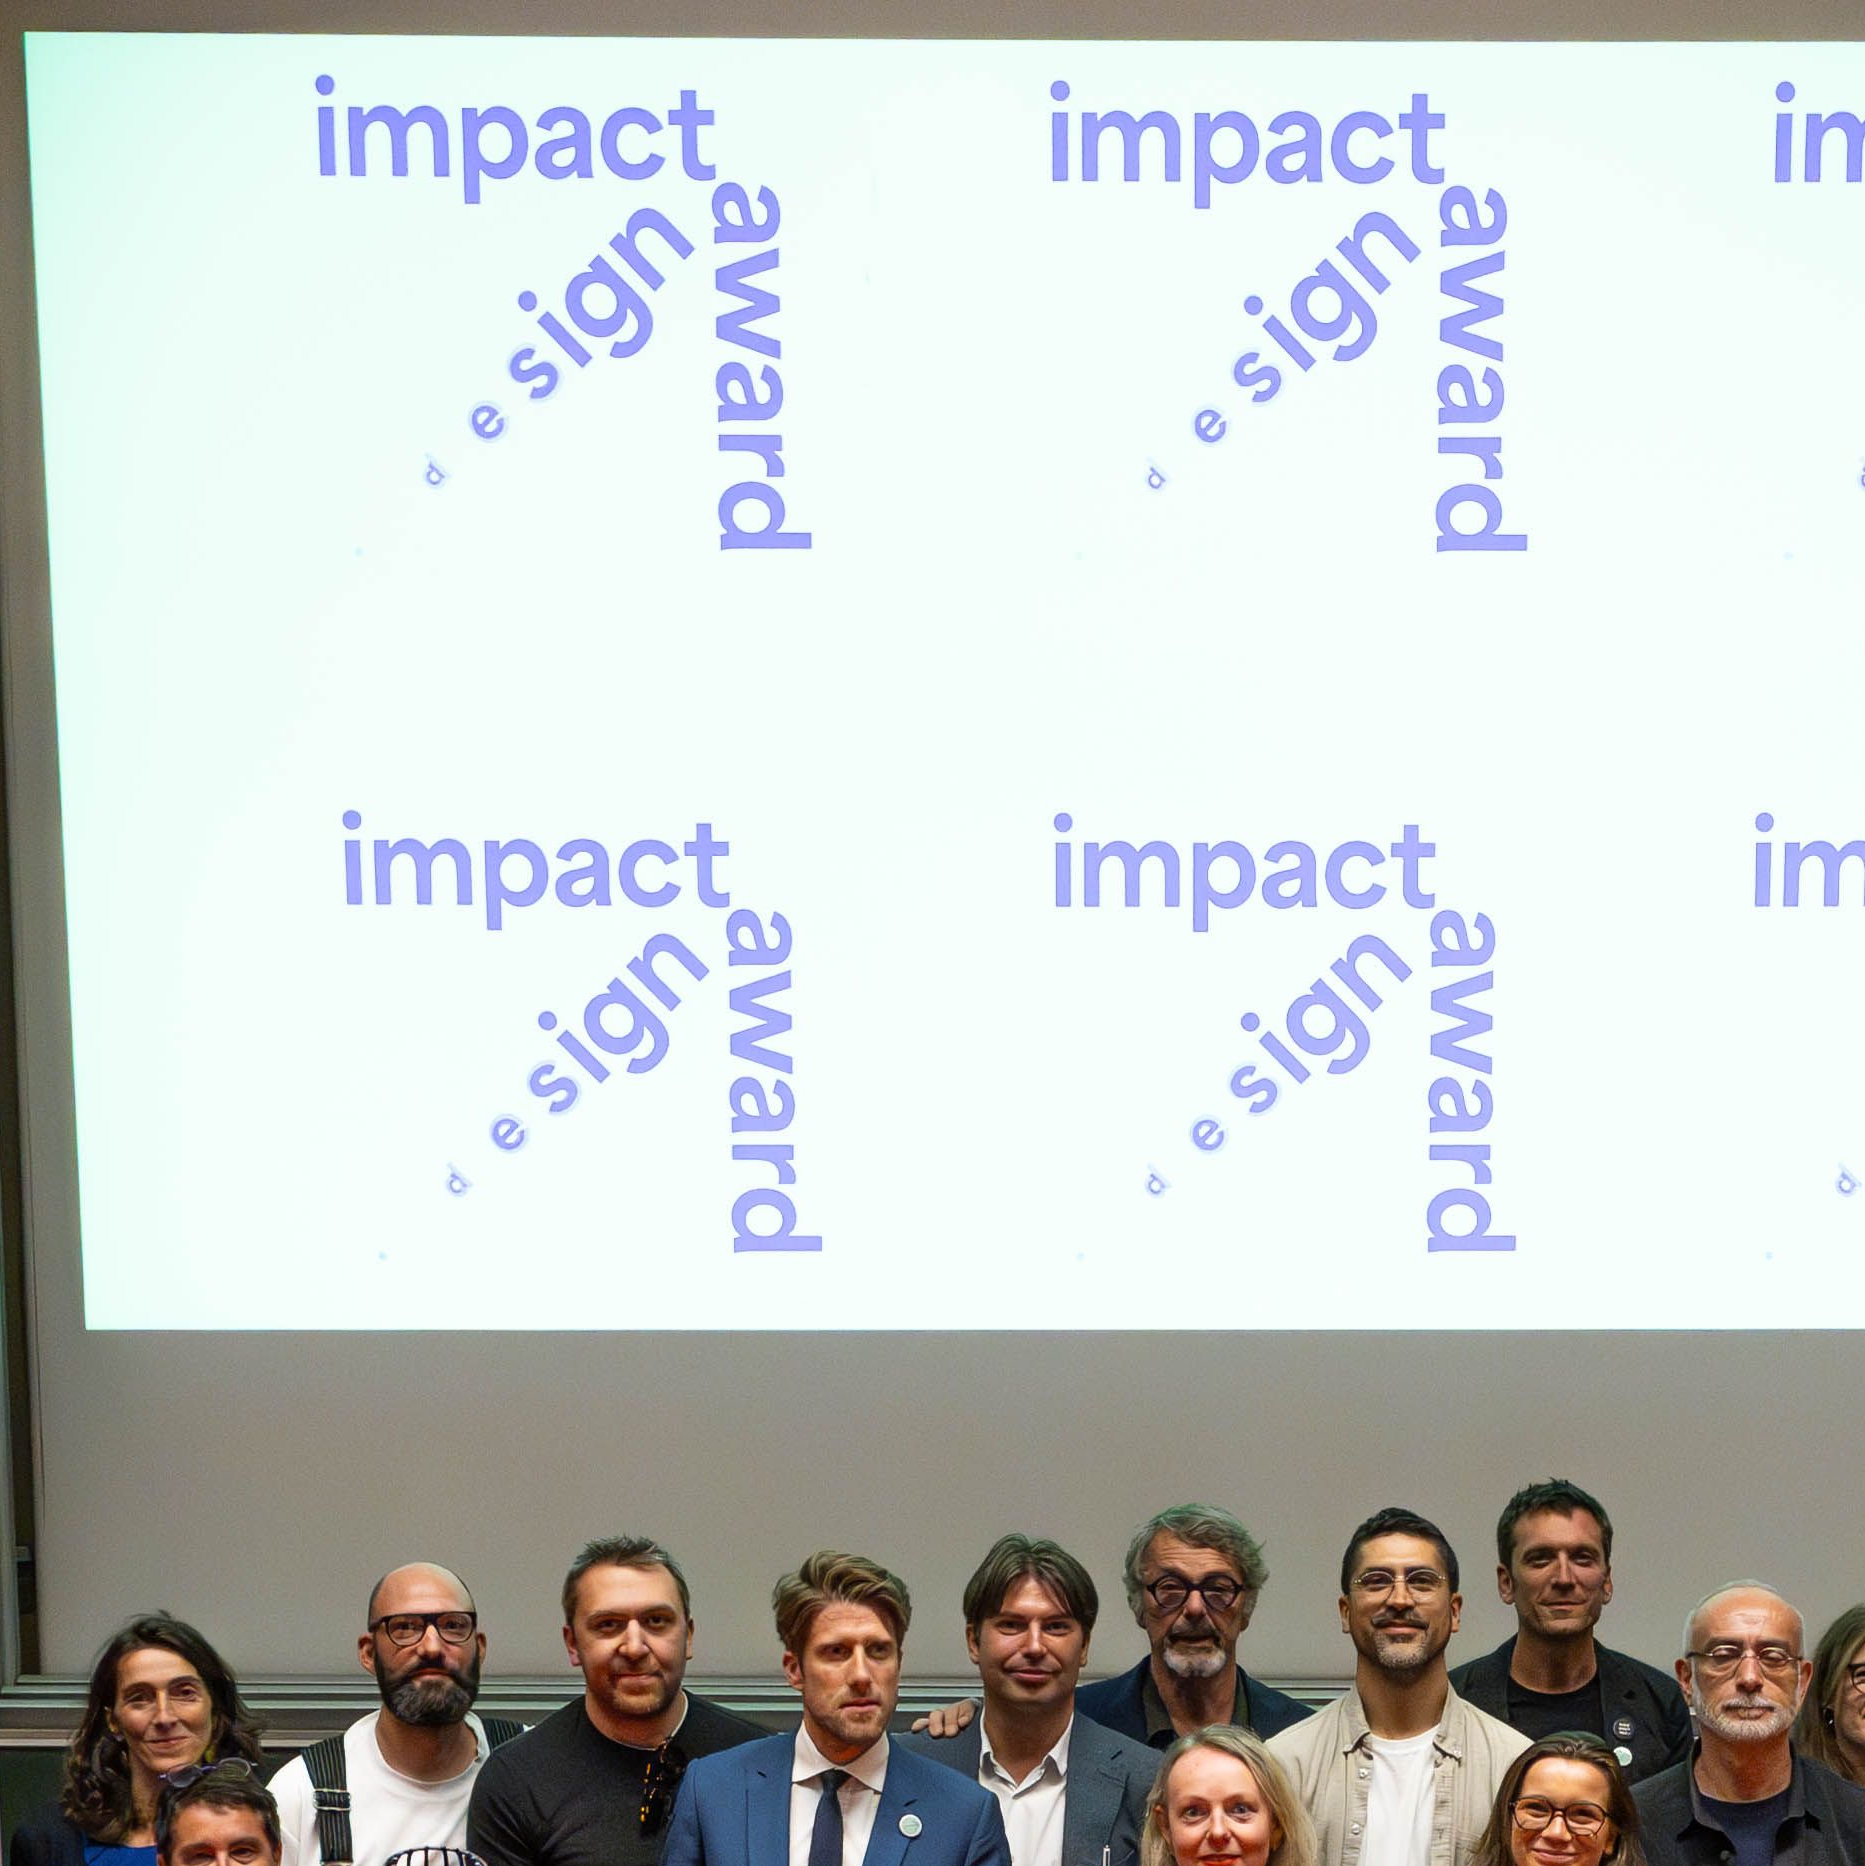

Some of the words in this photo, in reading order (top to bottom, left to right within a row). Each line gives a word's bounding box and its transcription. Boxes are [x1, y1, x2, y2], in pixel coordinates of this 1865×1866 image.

[313, 72, 717, 205] impact
[1050, 80, 1446, 209] impact
[423, 206, 695, 488] design
[711, 181, 813, 551] award
[1146, 210, 1422, 490] design
[1435, 184, 1528, 553] award
[342, 809, 731, 931] impact
[1053, 812, 1436, 933] impact
[446, 932, 710, 1196] design
[726, 908, 822, 1254] award
[1147, 933, 1413, 1195] design
[1426, 909, 1517, 1253] award
